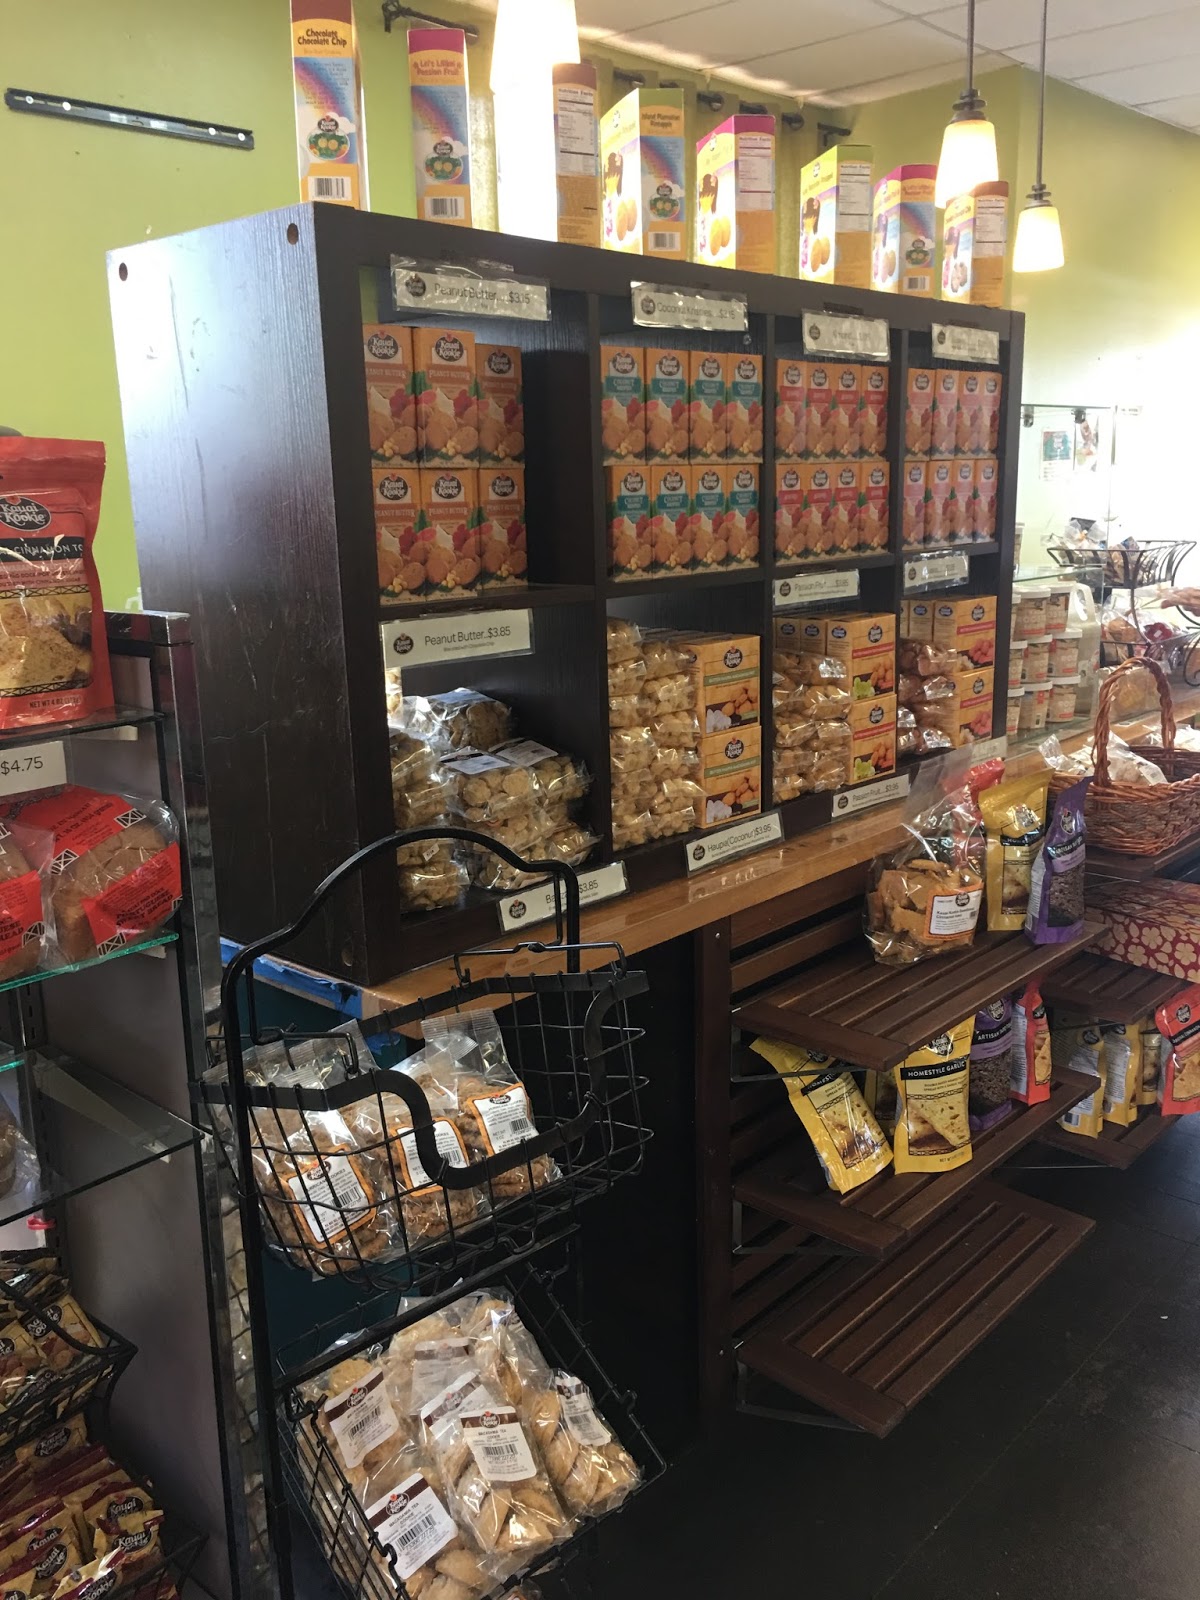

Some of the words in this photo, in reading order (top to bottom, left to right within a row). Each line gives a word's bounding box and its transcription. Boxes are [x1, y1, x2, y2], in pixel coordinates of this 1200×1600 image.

[306, 28, 338, 38] Chocolate
[298, 37, 330, 46] Chocolate
[331, 37, 347, 48] Chip
[434, 283, 468, 298] Peanut
[372, 338, 394, 348] Kauai
[441, 340, 460, 350] Kauai
[372, 347, 396, 357] Kookie
[439, 349, 460, 360] Kookie
[383, 480, 404, 489] Kauai
[439, 480, 458, 489] Kauai
[383, 487, 405, 498] Kookie
[438, 487, 459, 498] Kookie
[0, 503, 38, 513] Kauai
[4, 511, 46, 526] Kookie
[425, 633, 456, 646] Peanut
[488, 626, 511, 639] $3.85
[1, 755, 44, 776] $4.75
[978, 1031, 999, 1041] ARTISAN
[908, 1066, 945, 1077] HOMESTYLE
[946, 1061, 965, 1072] GARLIC
[110, 1498, 137, 1515] Kauai
[30, 1531, 59, 1551] Kauai
[118, 1532, 146, 1547] Kauai
[35, 1547, 60, 1571] Kauai
